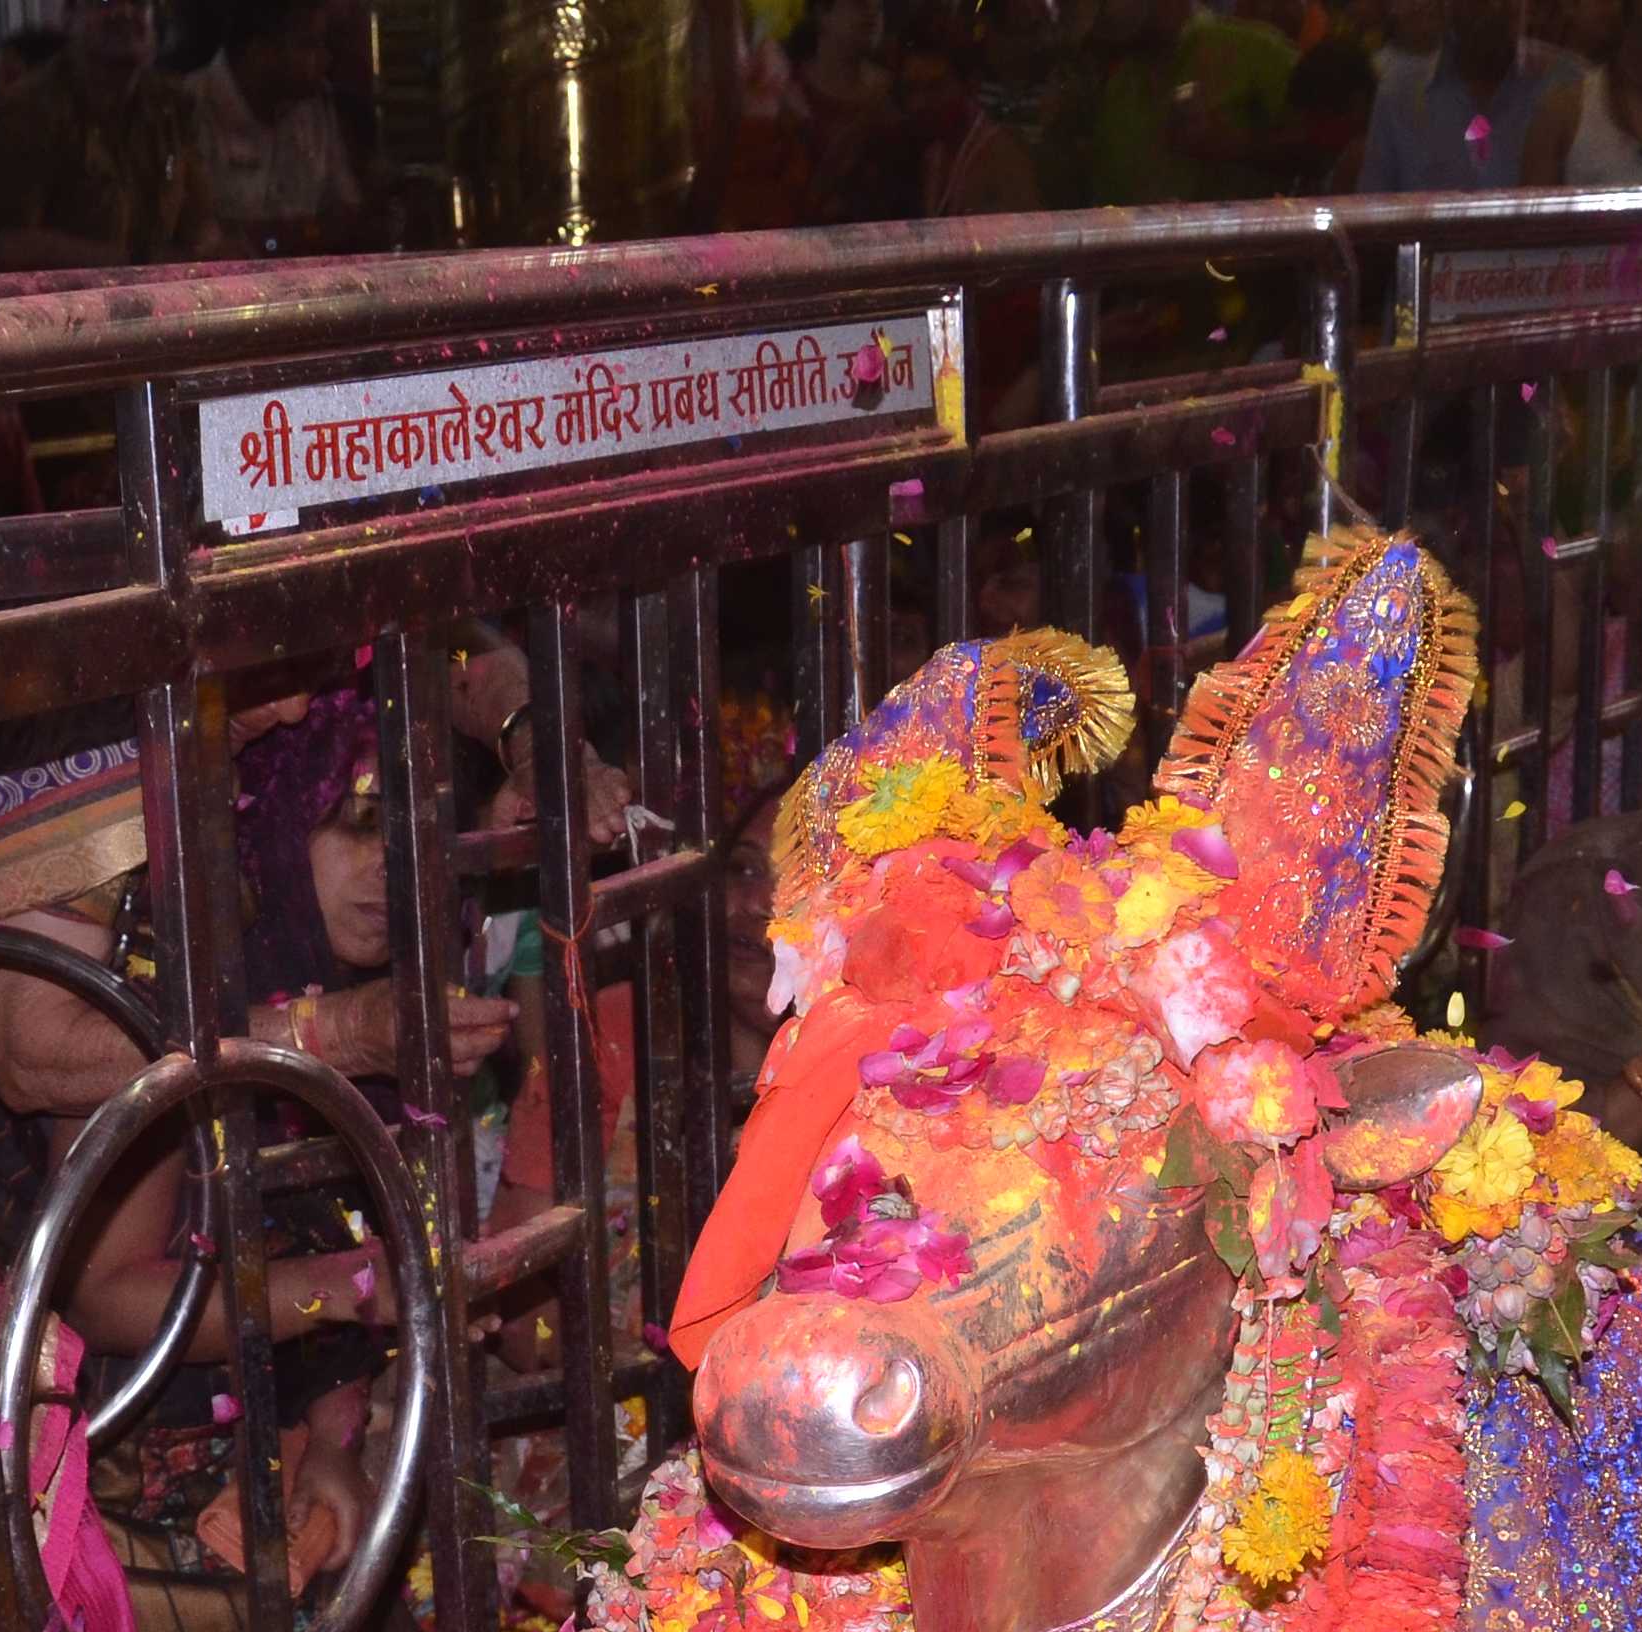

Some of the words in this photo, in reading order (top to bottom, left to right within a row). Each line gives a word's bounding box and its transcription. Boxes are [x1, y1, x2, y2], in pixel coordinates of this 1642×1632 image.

[239, 400, 292, 488] श्री
[303, 382, 546, 481] महाकालेश्वर
[553, 363, 643, 443] मंदिर
[649, 352, 720, 430] प्रबंध
